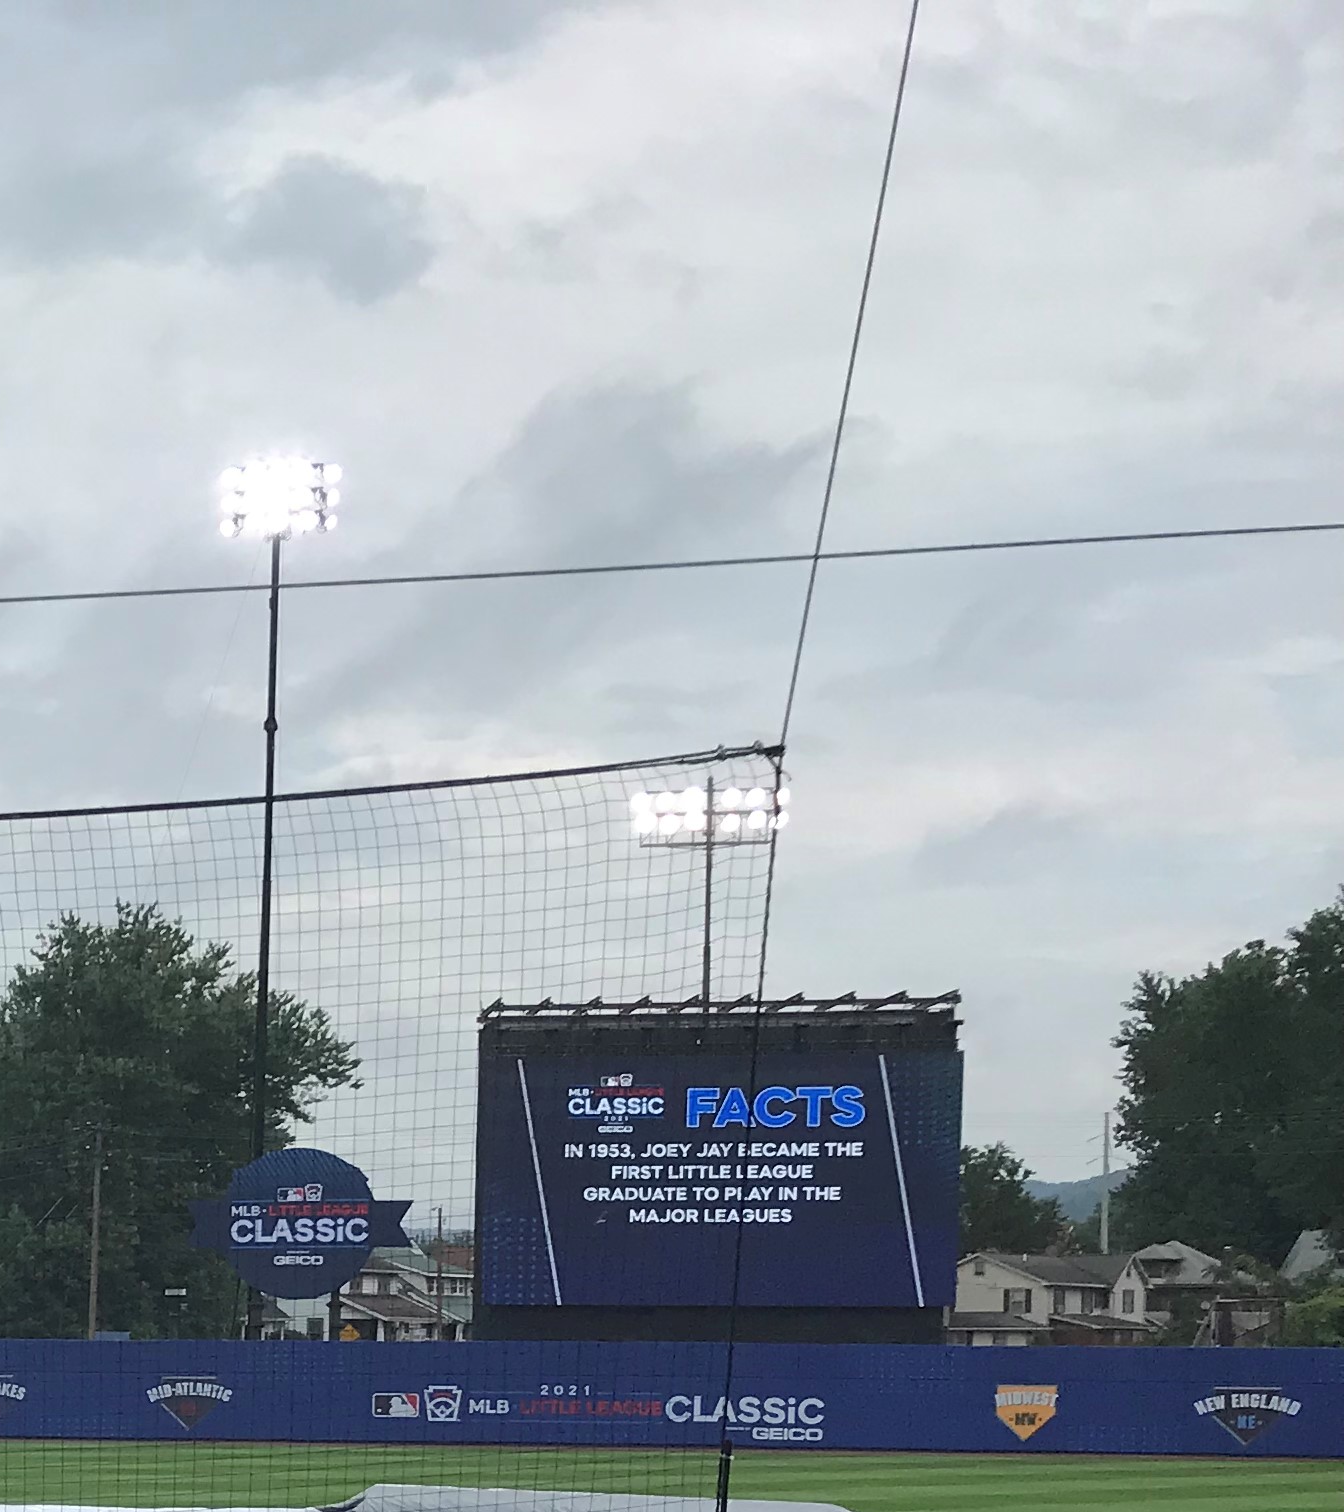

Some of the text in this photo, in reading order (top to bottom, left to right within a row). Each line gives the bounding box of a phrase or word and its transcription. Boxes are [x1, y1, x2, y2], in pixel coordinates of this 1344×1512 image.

[568, 1088, 590, 1097] MLB
[686, 1085, 866, 1128] FACTS
[564, 1142, 864, 1160] IN 1953, JOEY JAY BECAME THE
[611, 1164, 813, 1179] FIRST LITTLE LEAGUE
[583, 1186, 841, 1201] GRADUATE TO PLAY IN THE
[231, 1205, 261, 1217] MLB
[629, 1208, 793, 1223] MAJOR LEAGUES
[273, 1255, 324, 1266] GEICO
[146, 1382, 233, 1402] MID-ATLANTIC
[540, 1385, 591, 1396] 2021
[468, 1398, 510, 1414] MLB
[995, 1391, 1059, 1407] MIDWEST
[1193, 1393, 1302, 1416] NEW ENGLAND
[1237, 1415, 1256, 1429] NE
[752, 1427, 824, 1441] GEICO
